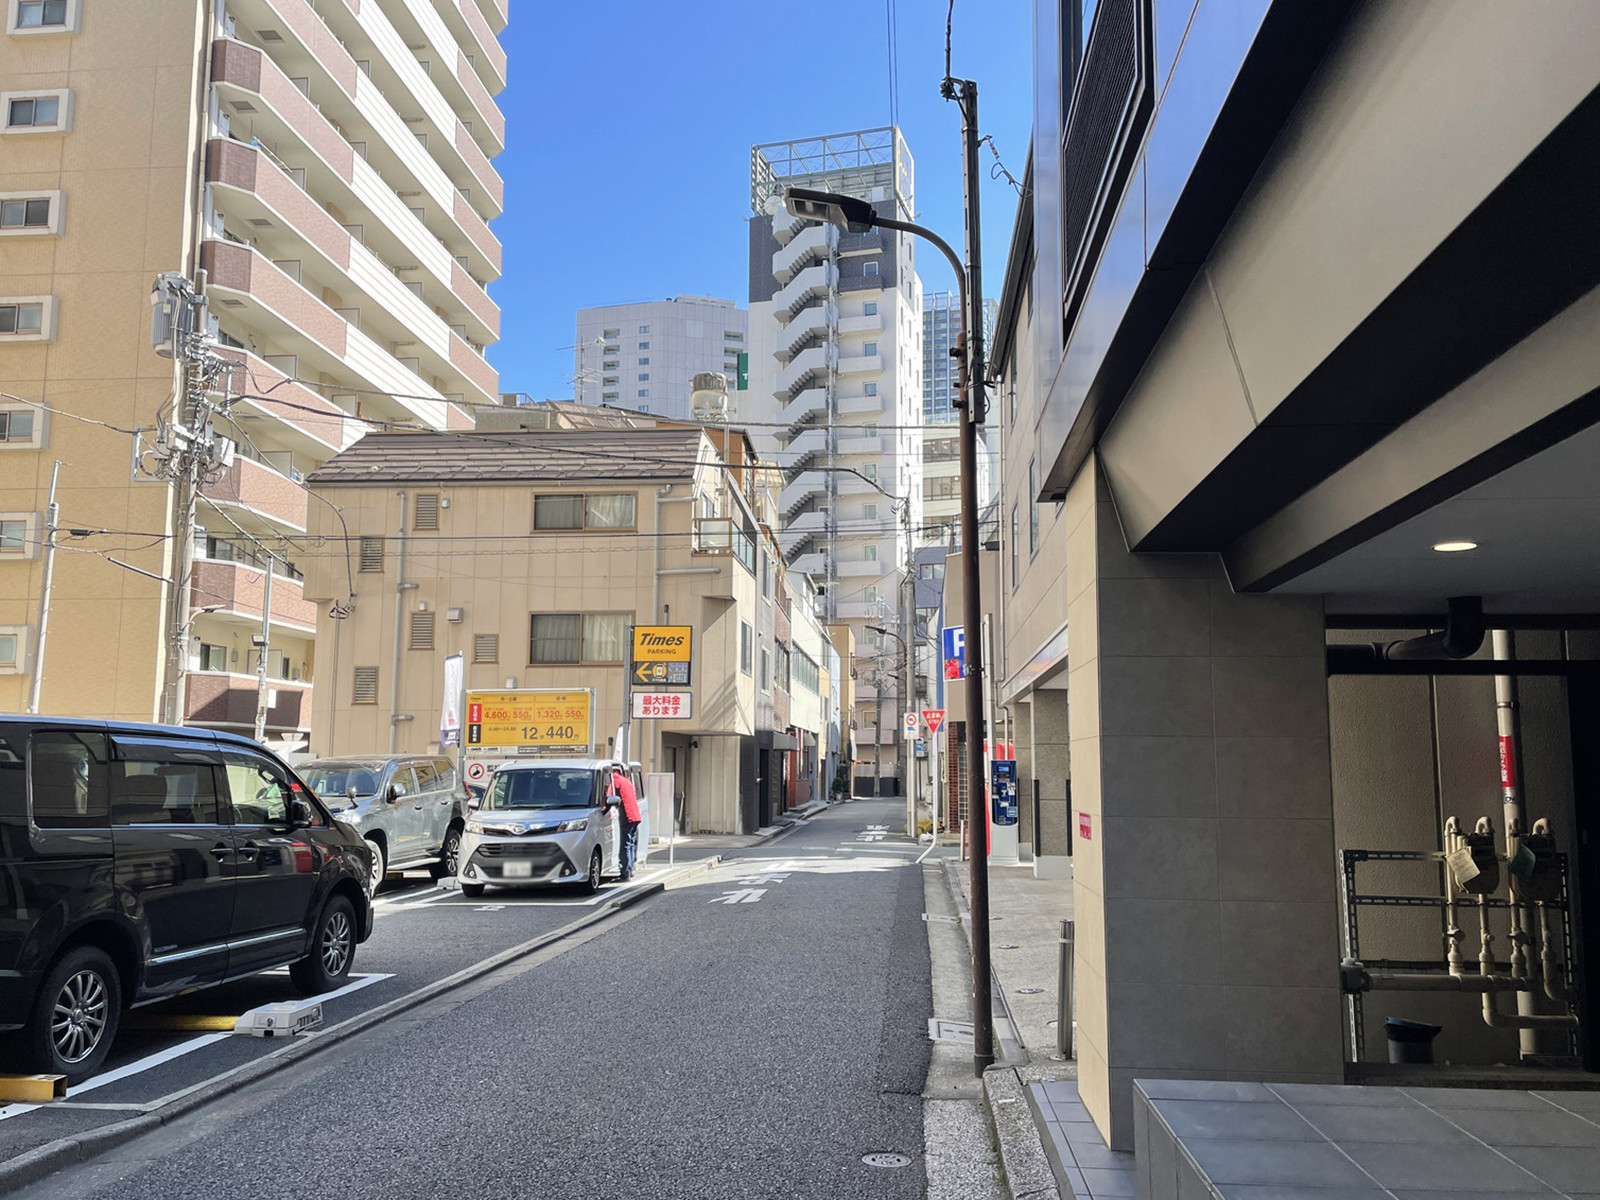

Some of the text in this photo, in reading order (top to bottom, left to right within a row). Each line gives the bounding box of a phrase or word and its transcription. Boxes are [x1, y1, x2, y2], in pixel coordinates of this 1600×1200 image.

[640, 633, 685, 646] Times
[642, 695, 681, 706] 最大料金
[642, 705, 681, 716] あります
